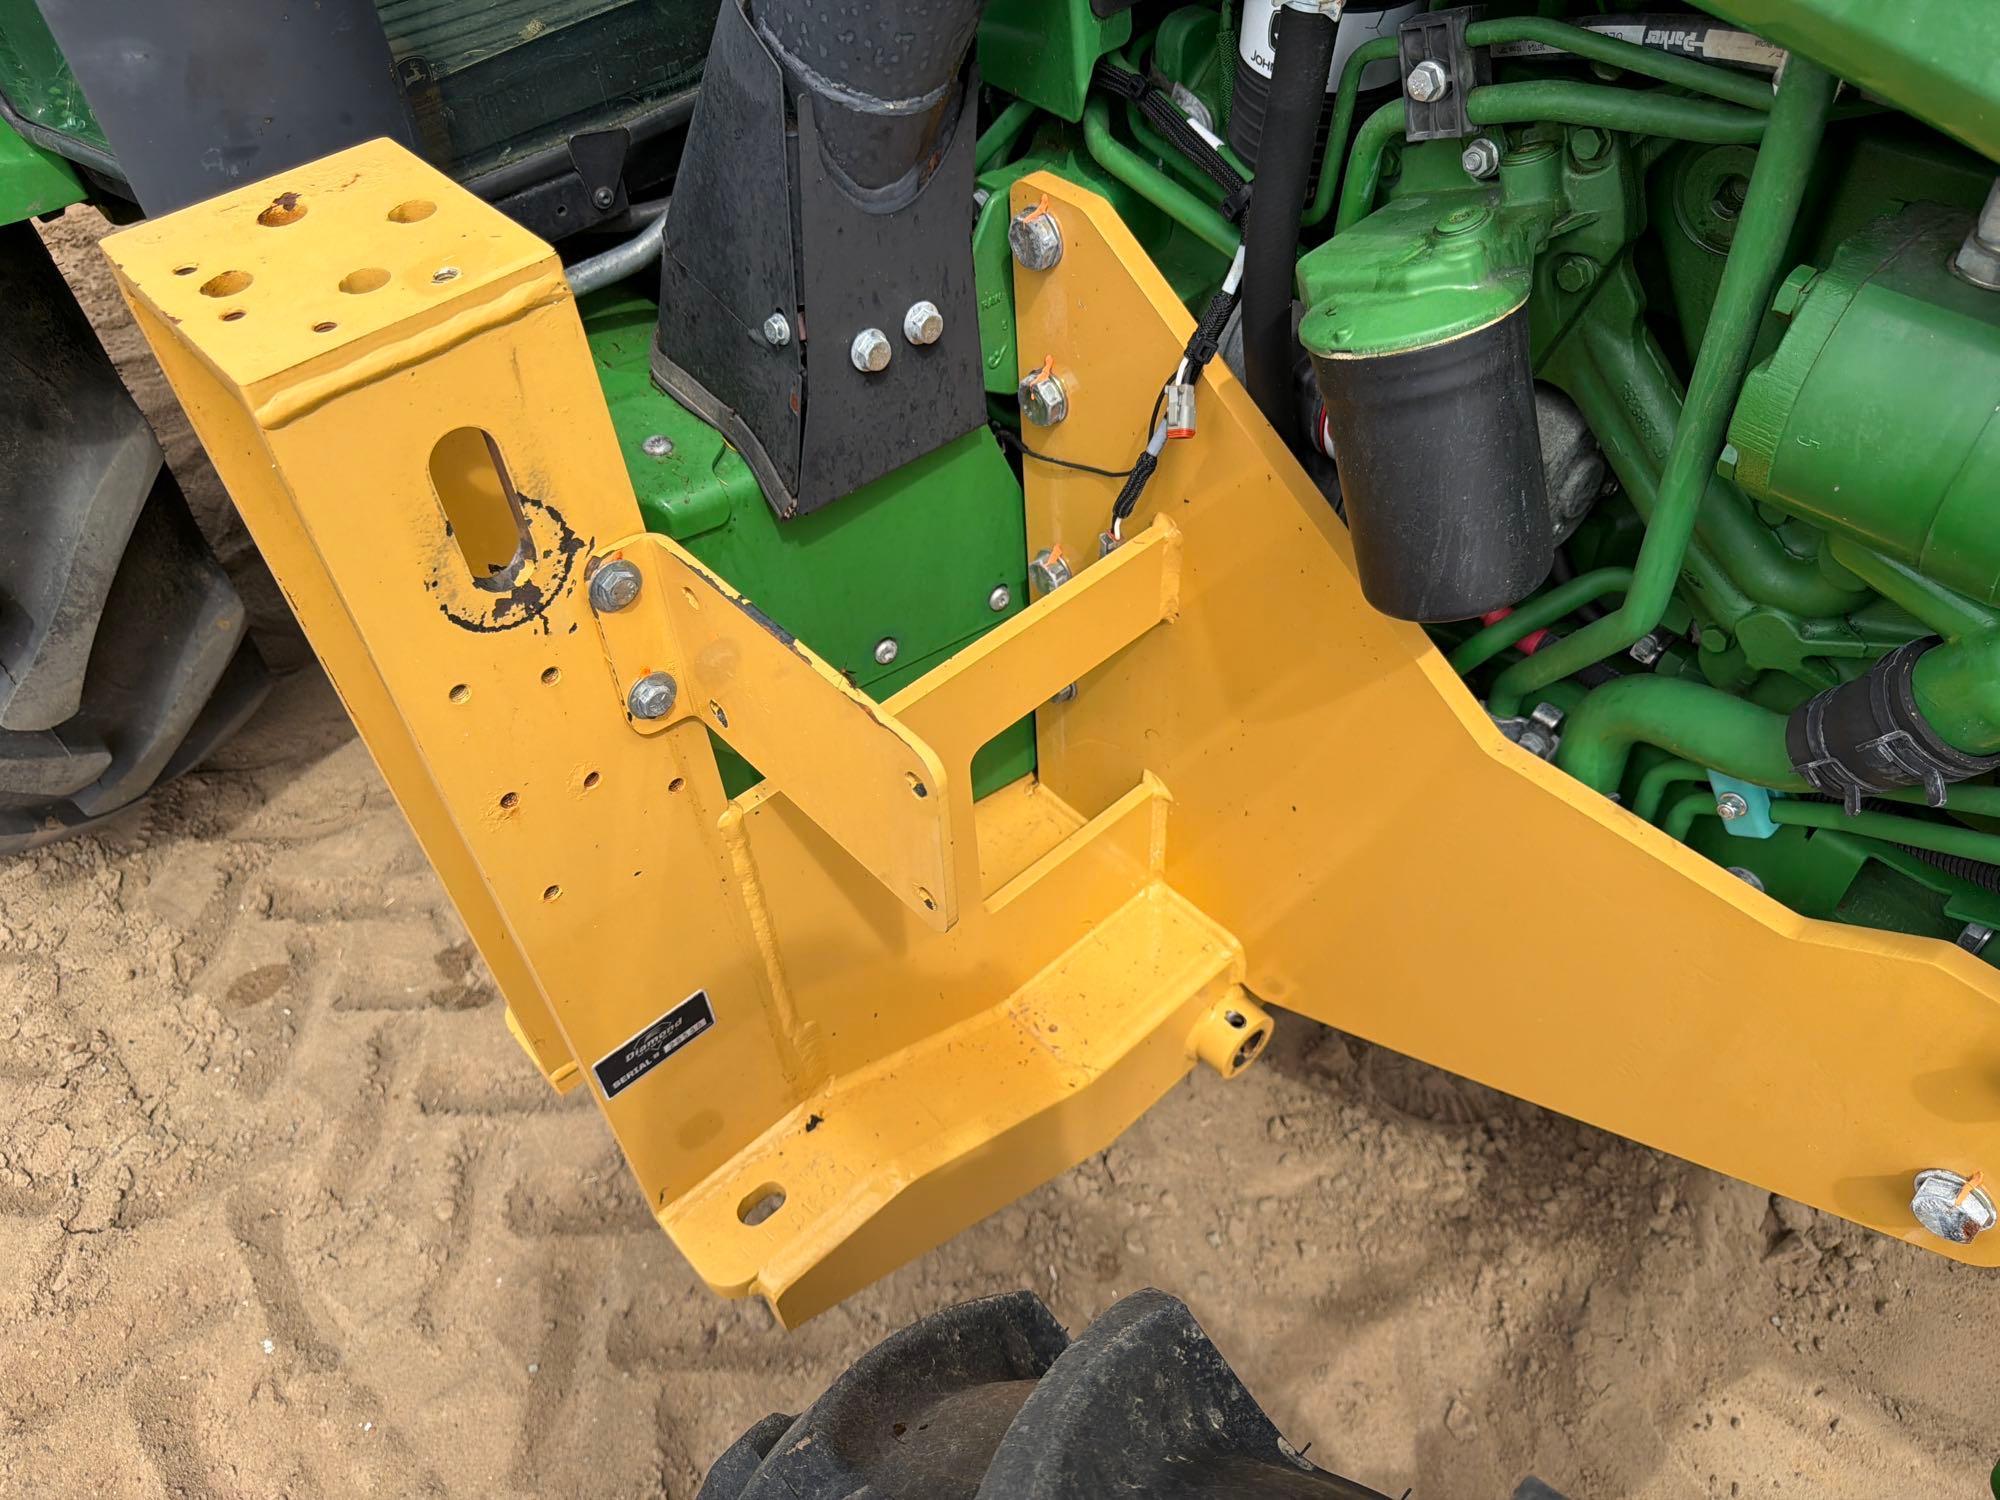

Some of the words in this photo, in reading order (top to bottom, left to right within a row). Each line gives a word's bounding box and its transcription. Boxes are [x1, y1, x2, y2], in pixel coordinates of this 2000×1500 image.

[1646, 30, 1697, 52] Parker
[625, 1016, 683, 1063] Diamond
[612, 1058, 653, 1089] SERIAL
